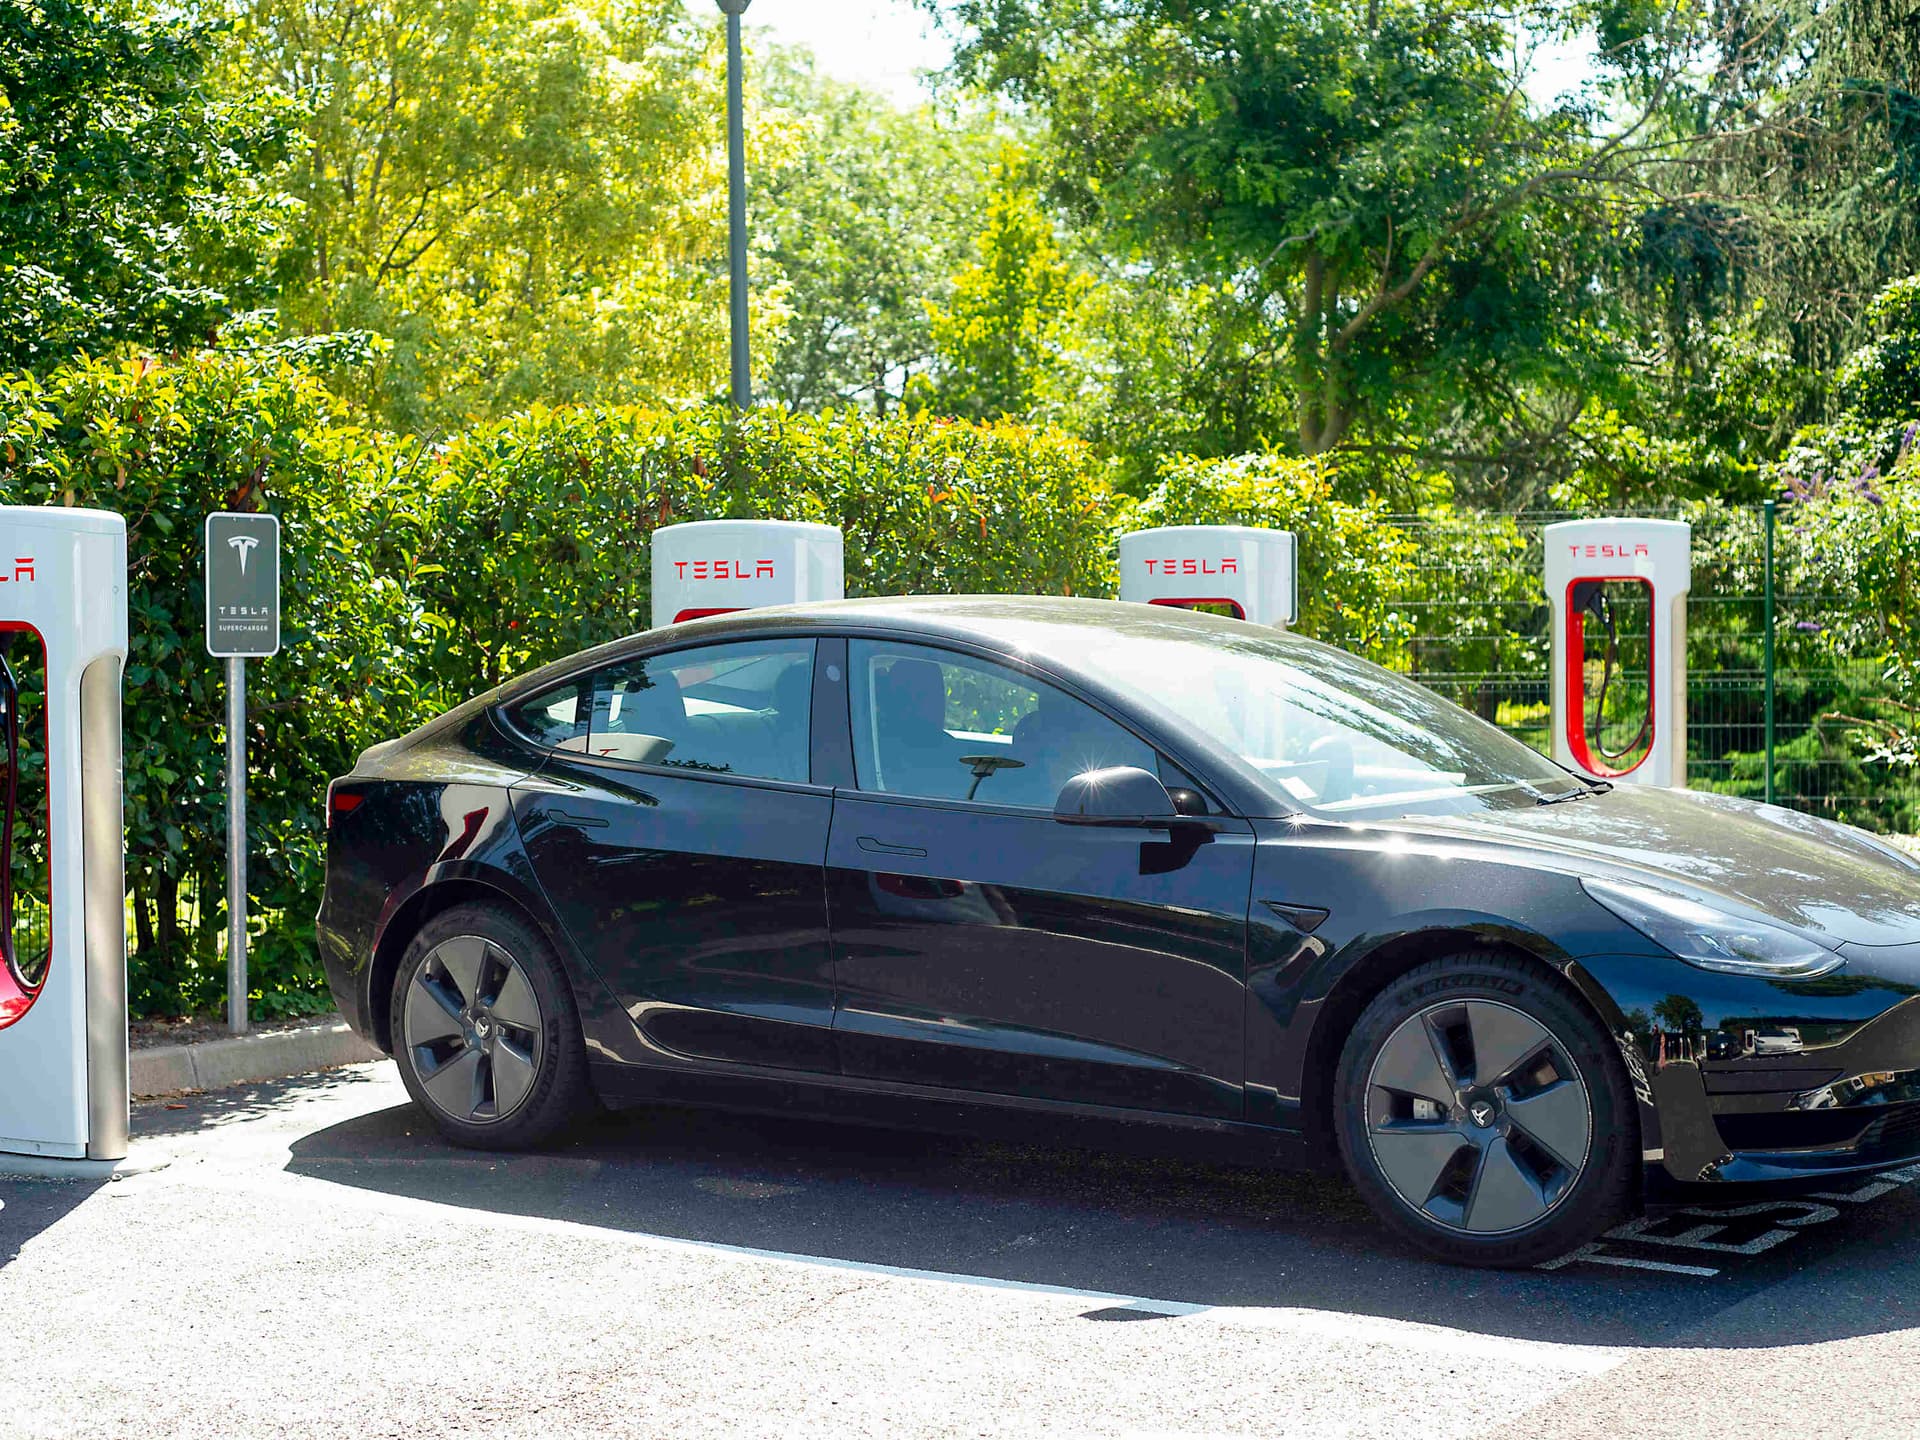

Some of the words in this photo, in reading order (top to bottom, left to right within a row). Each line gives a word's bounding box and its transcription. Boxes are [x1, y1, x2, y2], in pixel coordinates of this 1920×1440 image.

[1568, 544, 1648, 558] TESLA
[674, 560, 774, 580] TESLA
[1144, 558, 1237, 575] TESLA
[218, 606, 269, 616] TESLA
